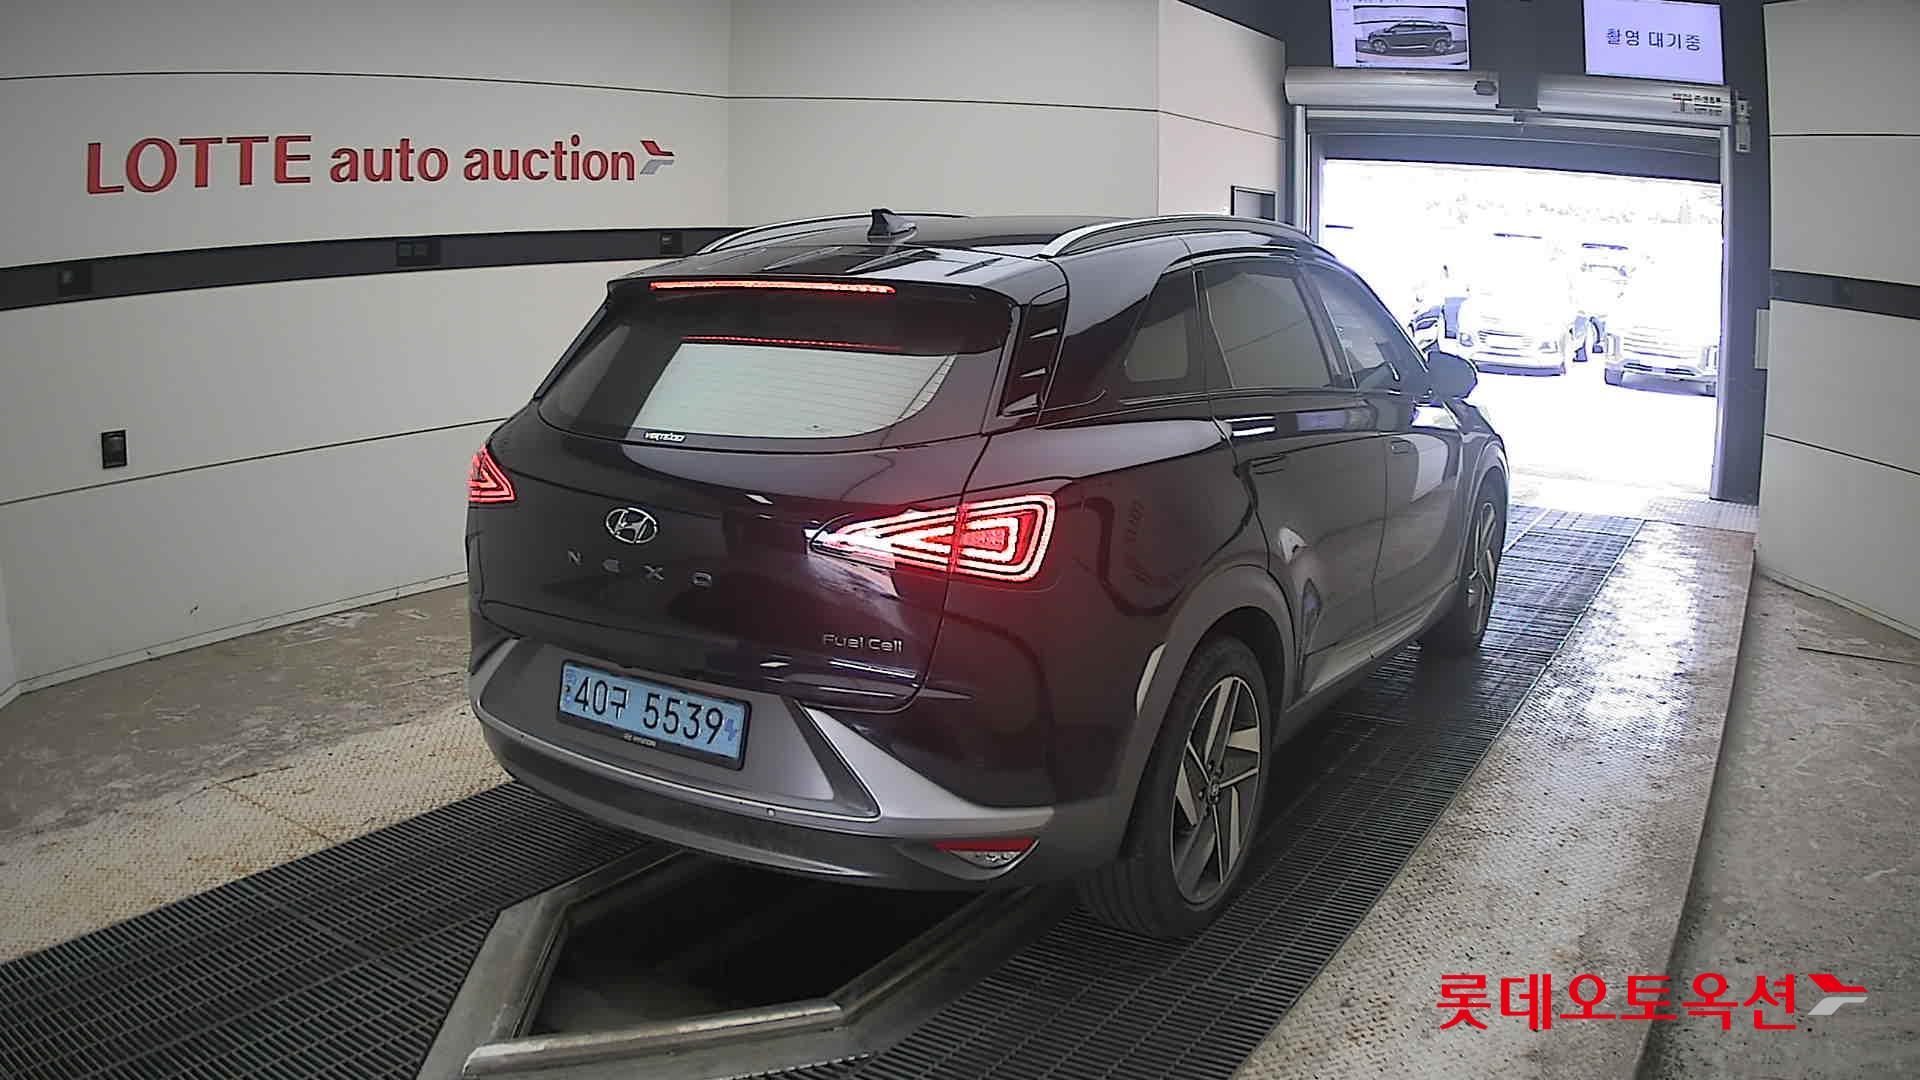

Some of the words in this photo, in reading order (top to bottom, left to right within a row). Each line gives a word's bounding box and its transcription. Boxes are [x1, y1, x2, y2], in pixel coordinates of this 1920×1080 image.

[1648, 31, 1701, 51] 대기중
[86, 135, 312, 195] LOTTE
[329, 137, 449, 184] auto
[463, 134, 636, 182] auction
[823, 633, 864, 649] Fuel
[868, 637, 903, 654] Cell
[574, 676, 627, 719] 40구
[643, 692, 724, 745] 5539
